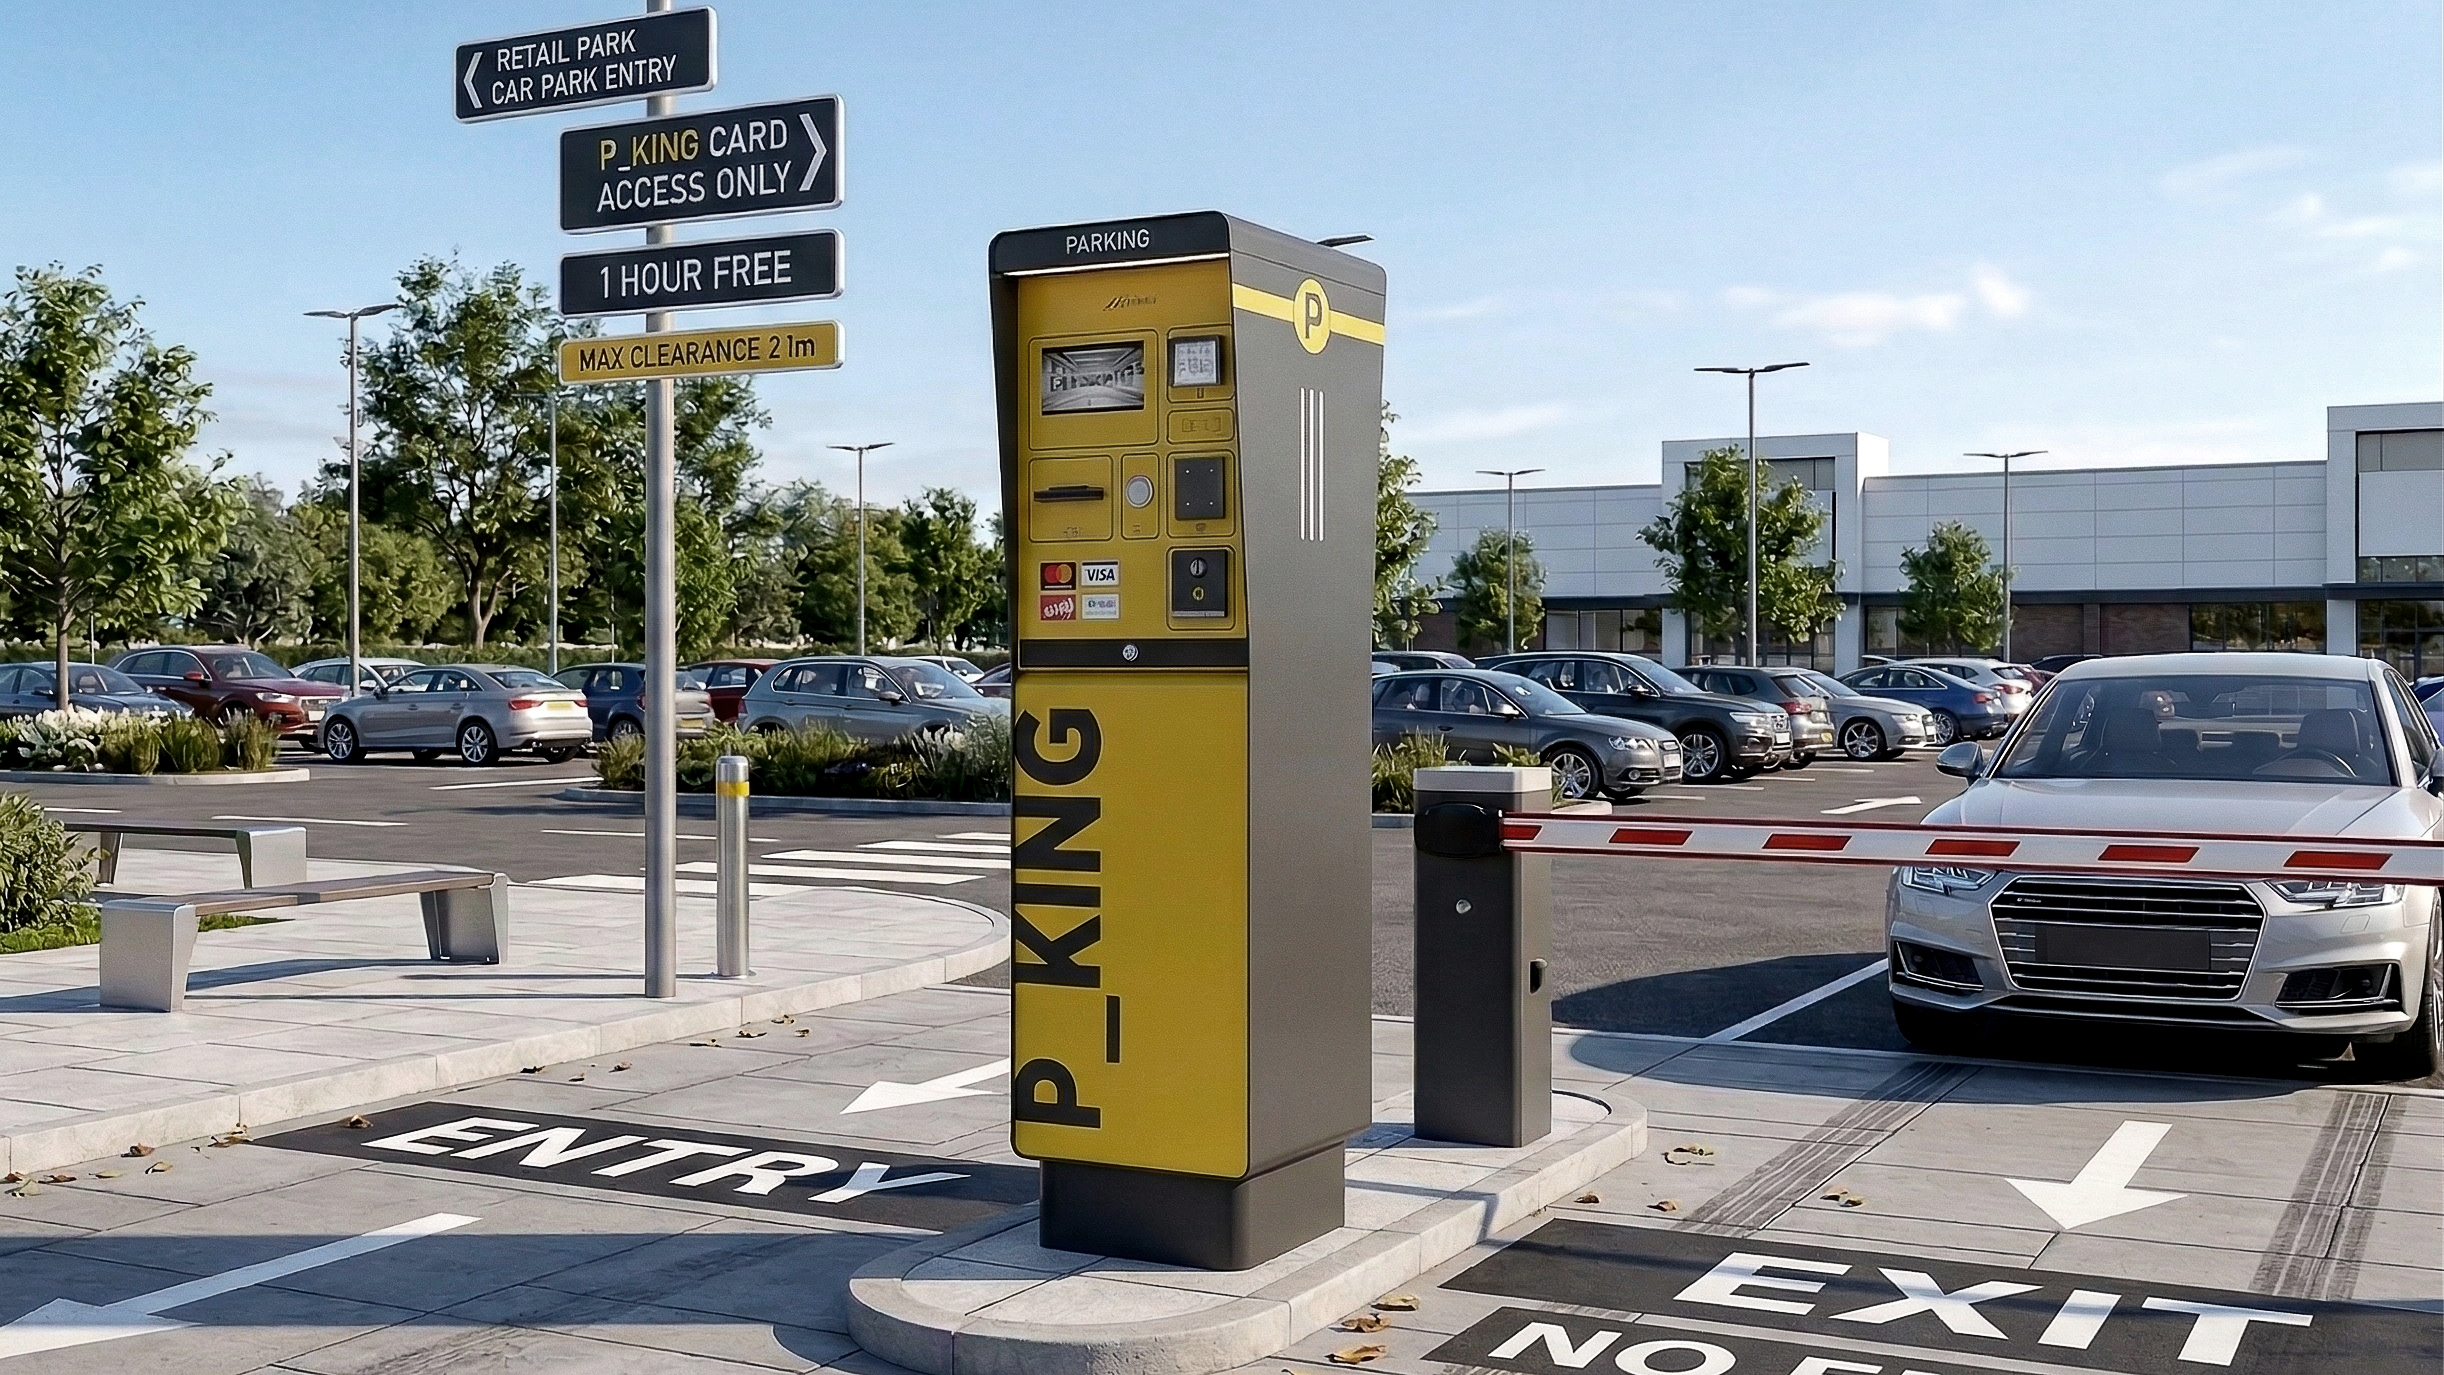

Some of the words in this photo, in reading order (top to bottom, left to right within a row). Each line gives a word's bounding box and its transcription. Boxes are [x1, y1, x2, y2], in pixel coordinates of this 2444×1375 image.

[497, 40, 570, 71] RETAIL
[577, 29, 636, 58] PARK
[492, 79, 534, 105] CAR
[541, 66, 598, 99] PARK
[605, 55, 677, 89] ENTRY
[600, 130, 699, 172] P_KING
[709, 119, 789, 156] CARD
[597, 172, 705, 212] ACCESS
[716, 161, 792, 199] ONLY
[1066, 229, 1150, 255] PARKING
[600, 267, 610, 298] 1
[621, 259, 702, 297] HOUR
[714, 250, 792, 289] FREE
[1304, 293, 1322, 339] P
[580, 349, 623, 371] MAX
[631, 337, 760, 368] CLEARANCE
[1086, 568, 1116, 582] VISA
[1015, 708, 1120, 1128] P_KING
[361, 1116, 972, 1203] ENTRY
[1673, 1252, 2313, 1367] EXIT
[1488, 1321, 1736, 1375] NO
